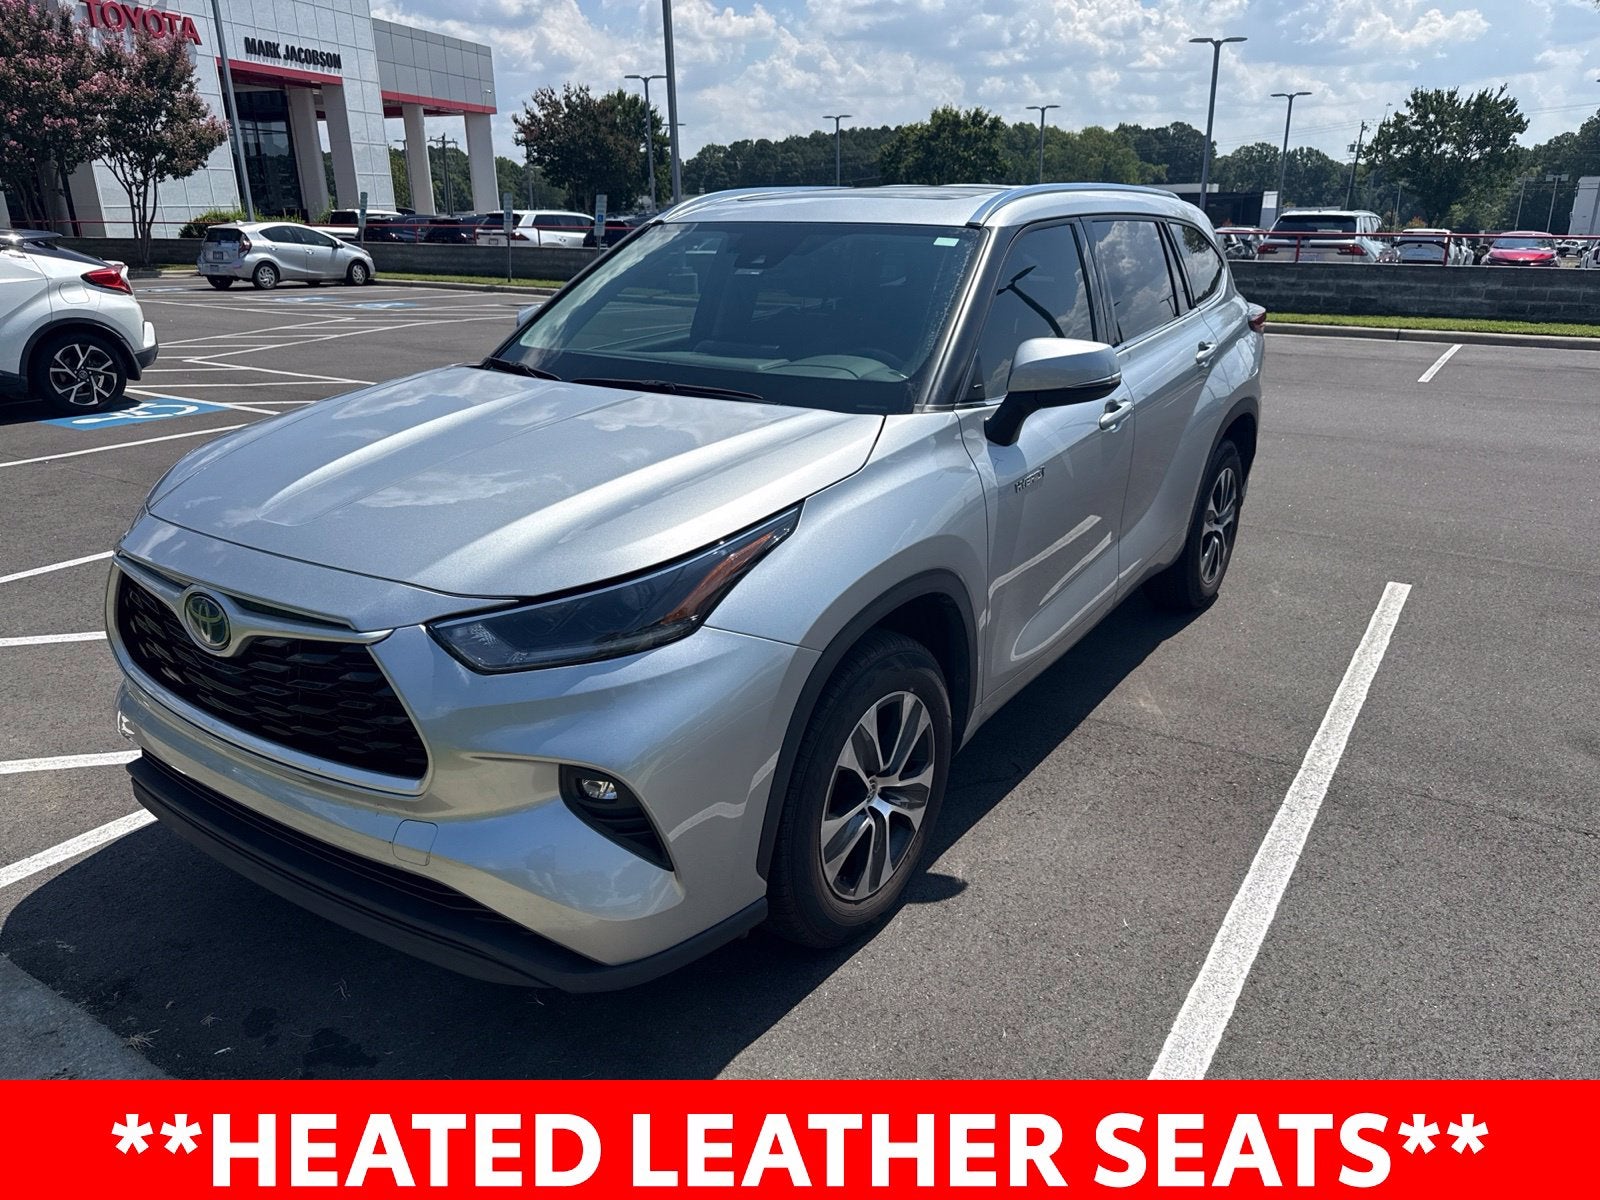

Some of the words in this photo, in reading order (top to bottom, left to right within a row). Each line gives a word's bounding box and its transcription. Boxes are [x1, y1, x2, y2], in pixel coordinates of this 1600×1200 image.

[79, 0, 203, 46] TOYOTA
[244, 36, 282, 60] MARK
[283, 44, 342, 70] JACOBSON
